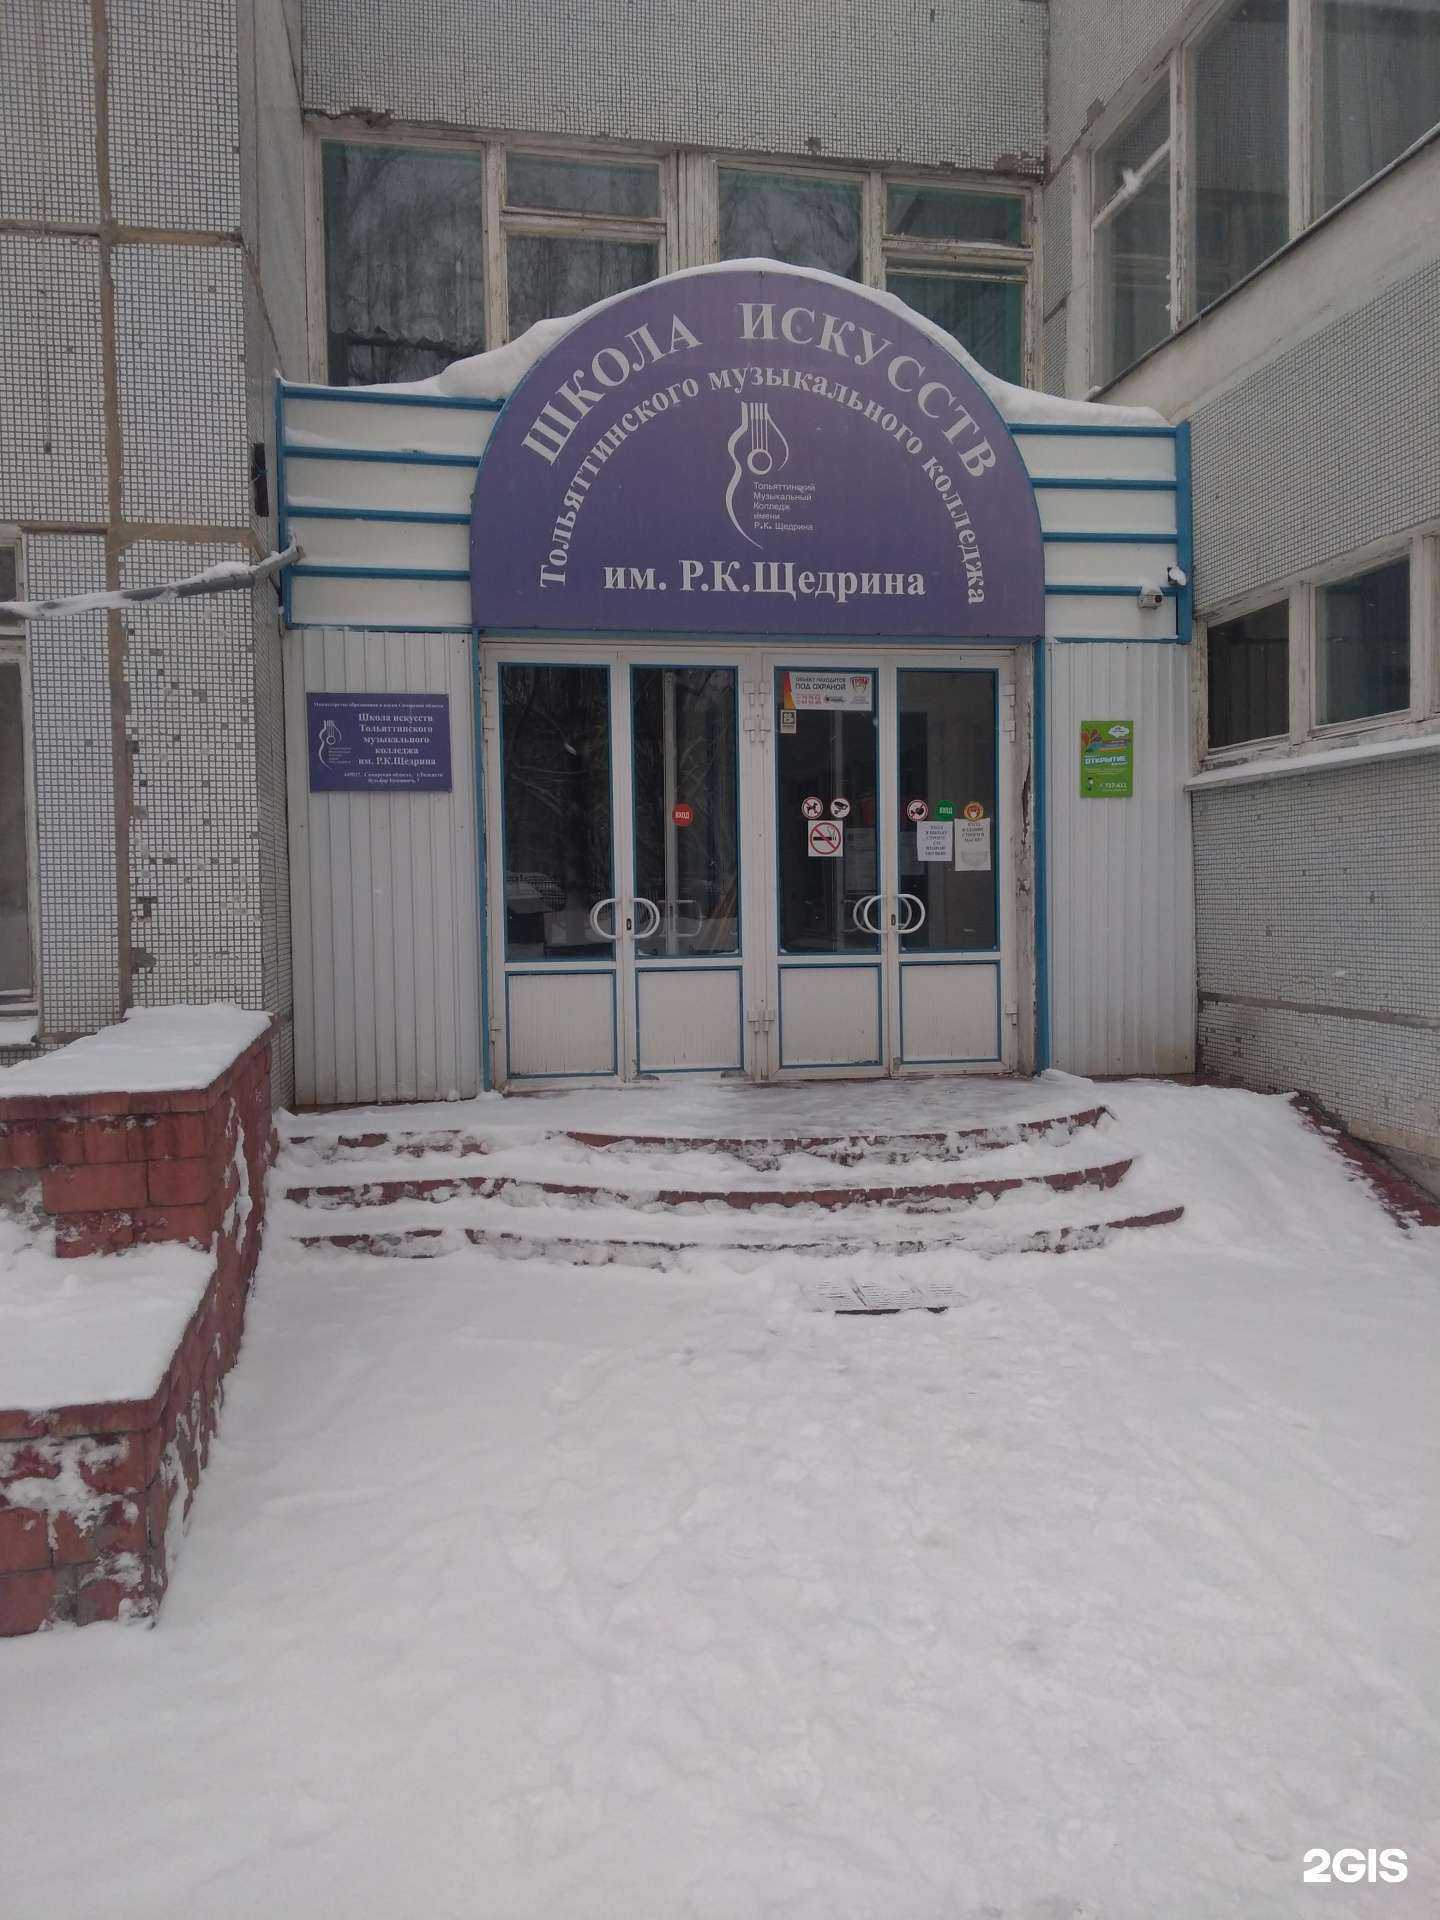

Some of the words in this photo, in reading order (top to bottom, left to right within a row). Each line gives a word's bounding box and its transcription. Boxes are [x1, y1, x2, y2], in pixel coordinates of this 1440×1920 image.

[520, 313, 703, 466] ШКОЛА
[737, 302, 997, 478] ИСКУССТВ
[540, 377, 700, 588] Тольяттинского
[708, 366, 923, 454] музыкального
[922, 456, 985, 605] колледжа
[753, 492, 812, 501] Музыкальный
[753, 502, 791, 511] Колледж
[754, 521, 772, 529] Р.К.
[775, 522, 814, 532] Щедрина
[604, 565, 668, 591] им.
[679, 559, 927, 603] Р.К.Щедрина
[358, 713, 391, 722] Школа
[393, 715, 433, 723] искусств
[360, 724, 433, 733] Тольяттинского
[363, 736, 430, 745] музыкального
[375, 747, 419, 756] колледжа
[358, 758, 373, 766] им.
